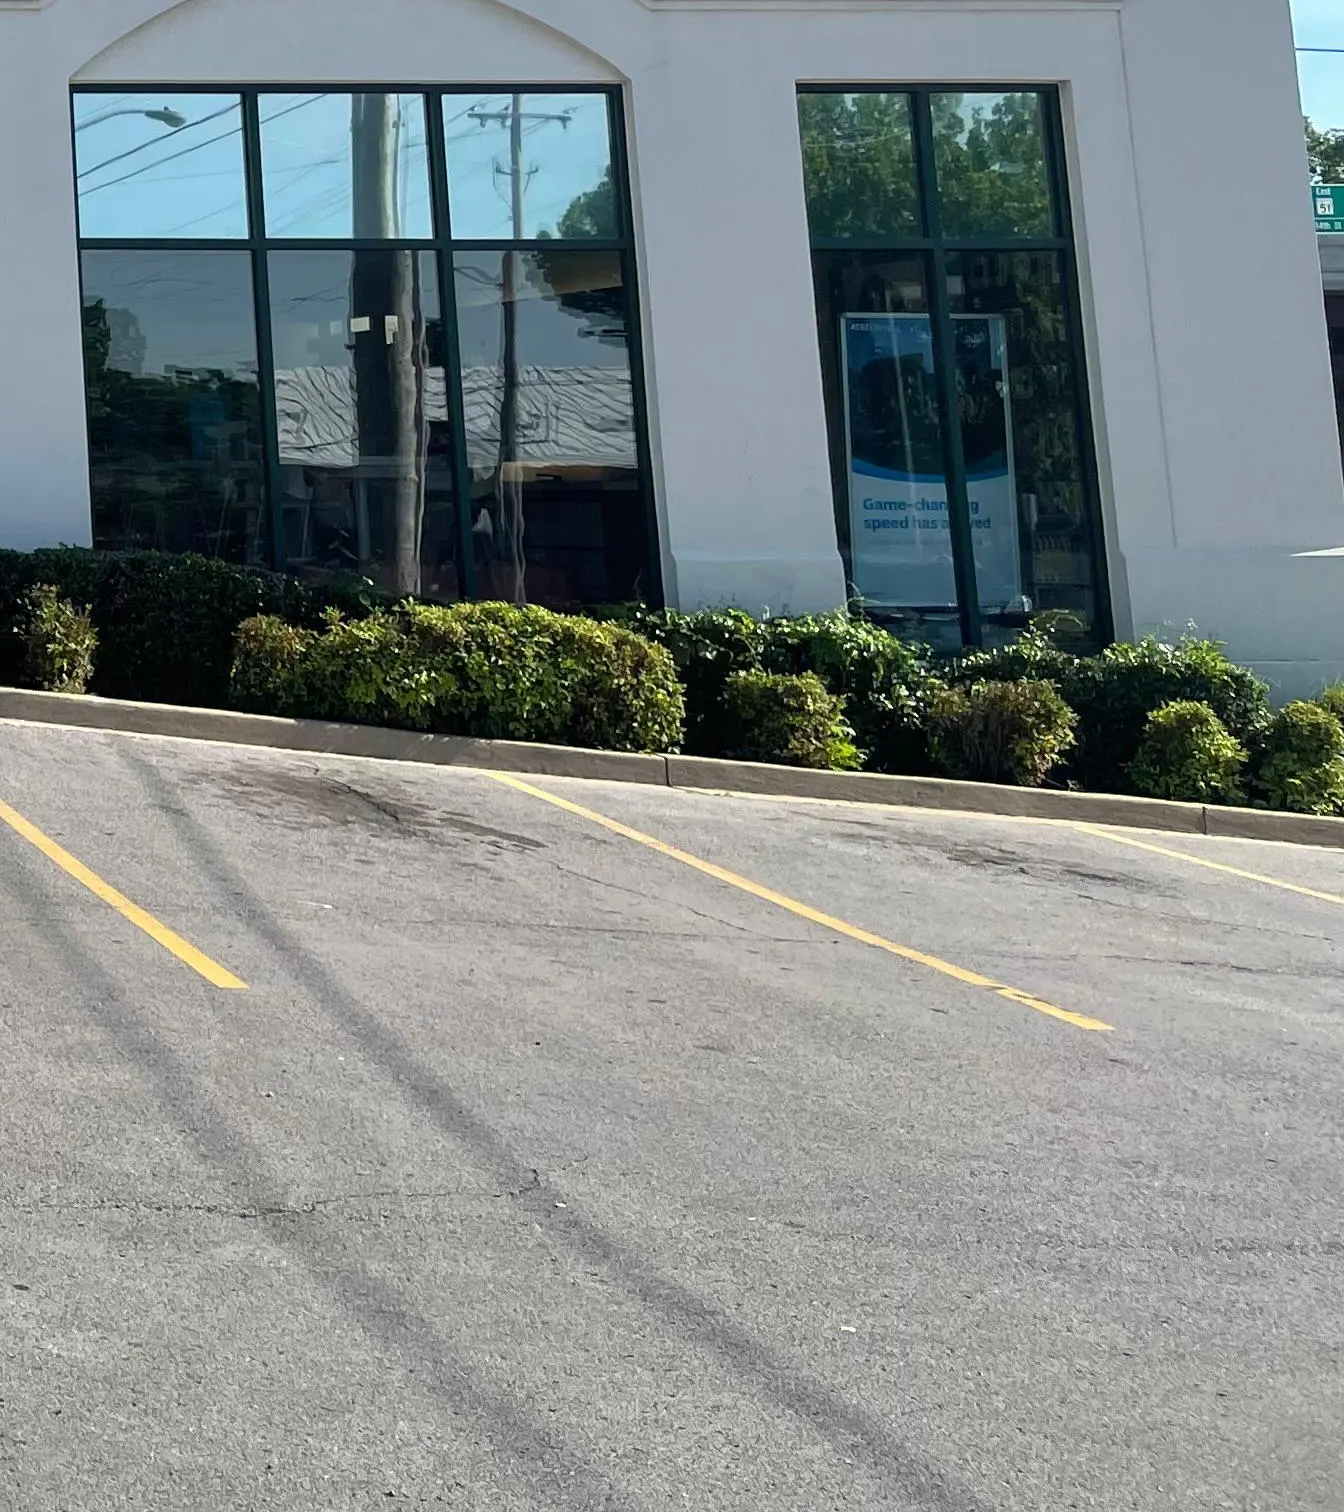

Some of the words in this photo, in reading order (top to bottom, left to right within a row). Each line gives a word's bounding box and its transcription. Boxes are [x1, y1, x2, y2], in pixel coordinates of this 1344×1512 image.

[1319, 203, 1331, 214] 51
[863, 498, 979, 514] Game-chang
[863, 516, 909, 532] speed
[913, 516, 938, 529] has
